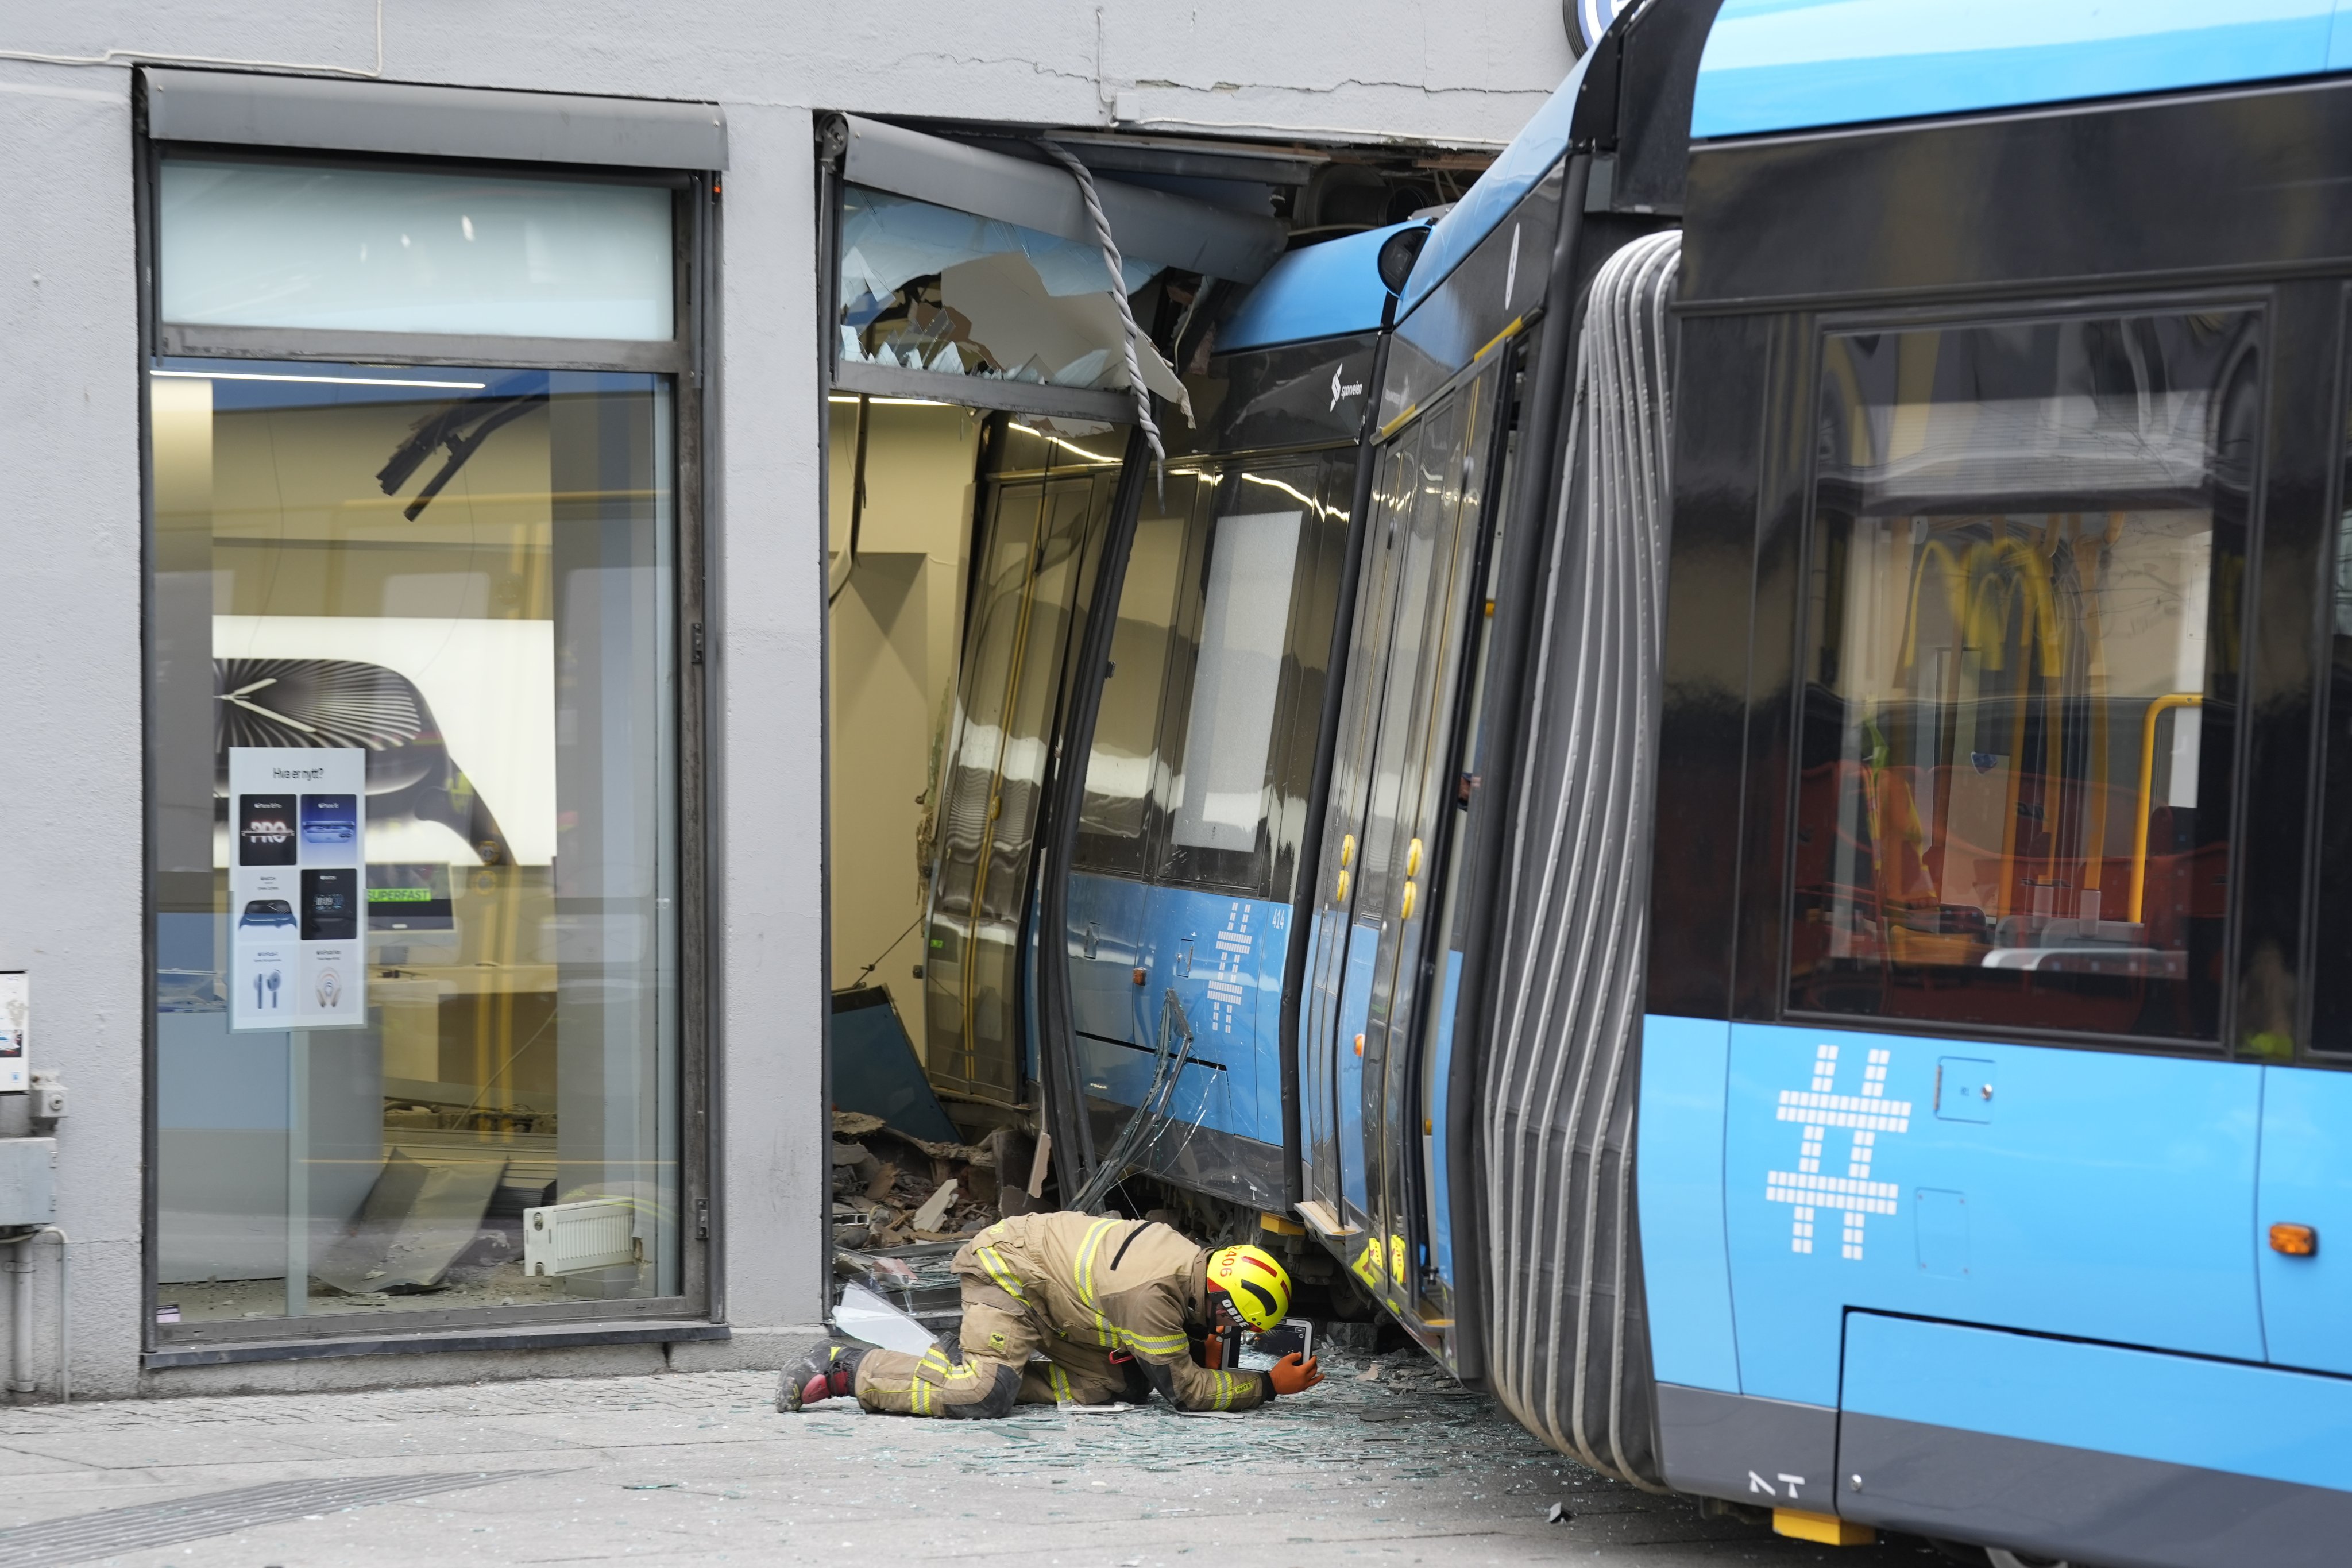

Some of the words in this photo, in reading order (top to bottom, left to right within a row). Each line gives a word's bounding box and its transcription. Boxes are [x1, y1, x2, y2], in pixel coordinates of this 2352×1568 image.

[272, 767, 291, 779] Hva
[291, 770, 300, 779] er
[302, 767, 325, 781] nytt?
[368, 889, 428, 900] SUPERFAST
[1272, 908, 1285, 930] 414
[1222, 1299, 1249, 1328] OBRE
